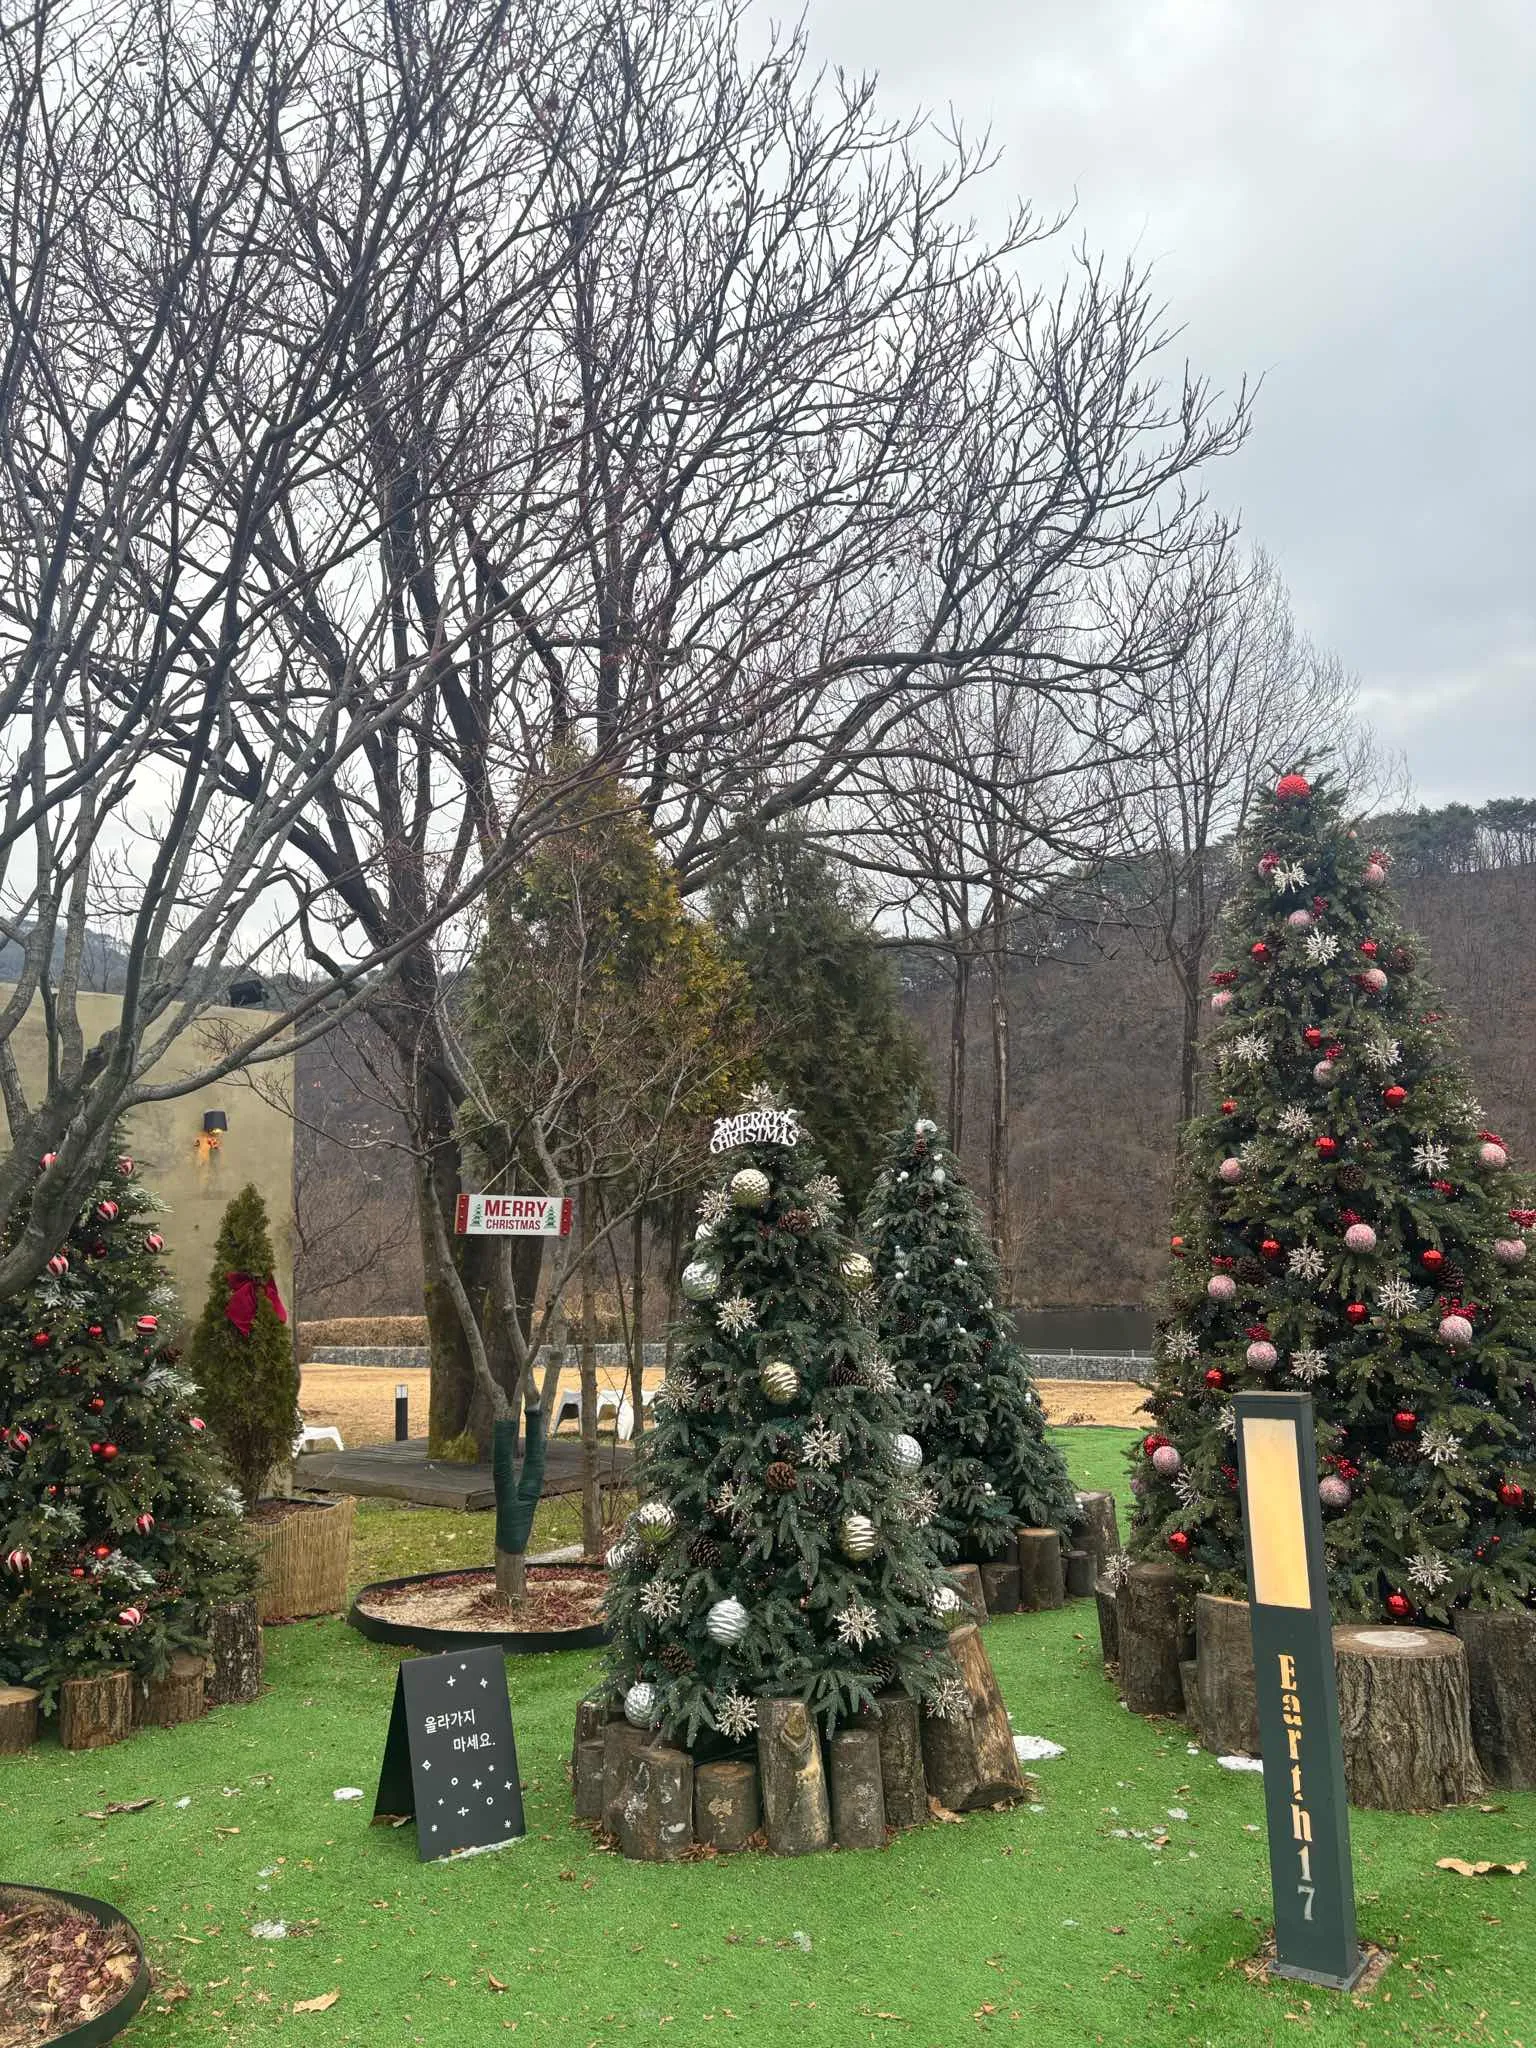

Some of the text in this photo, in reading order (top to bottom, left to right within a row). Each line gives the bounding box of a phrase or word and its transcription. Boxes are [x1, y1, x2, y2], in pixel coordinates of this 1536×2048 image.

[725, 1112, 784, 1131] MERRY
[710, 1127, 799, 1154] CHRISTMAS
[485, 1200, 547, 1217] MERRY
[486, 1219, 541, 1230] CHRISTMAS
[424, 1708, 476, 1734] 올라가지
[453, 1732, 496, 1752] 마세요.
